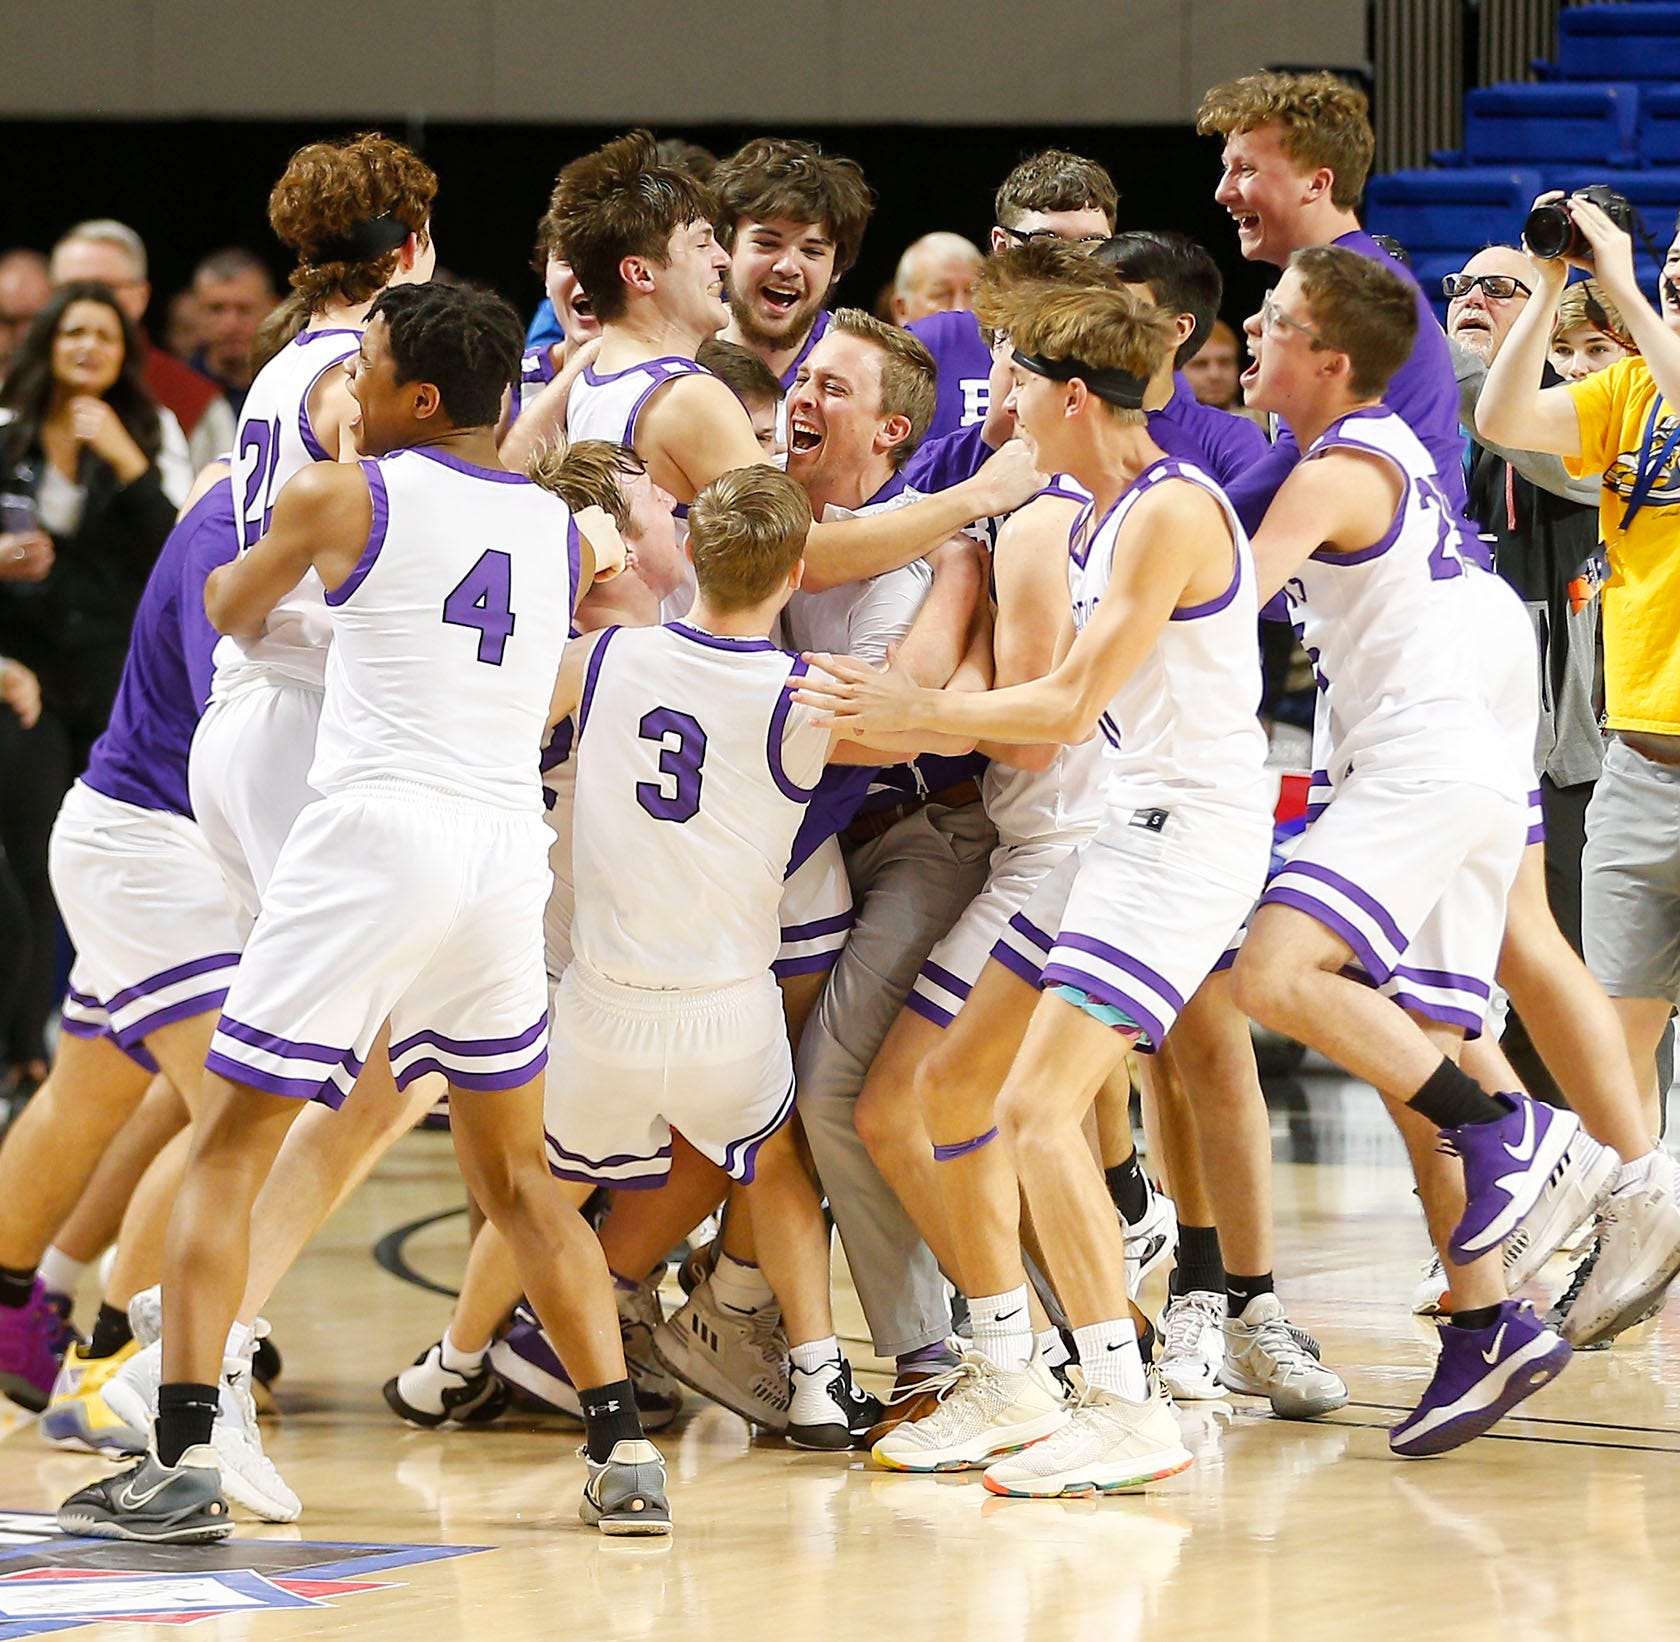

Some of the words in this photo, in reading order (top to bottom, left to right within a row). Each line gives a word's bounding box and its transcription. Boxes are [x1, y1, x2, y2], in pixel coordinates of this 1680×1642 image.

[1414, 475, 1468, 581] 2
[442, 548, 516, 666] 4
[636, 706, 708, 824] 3
